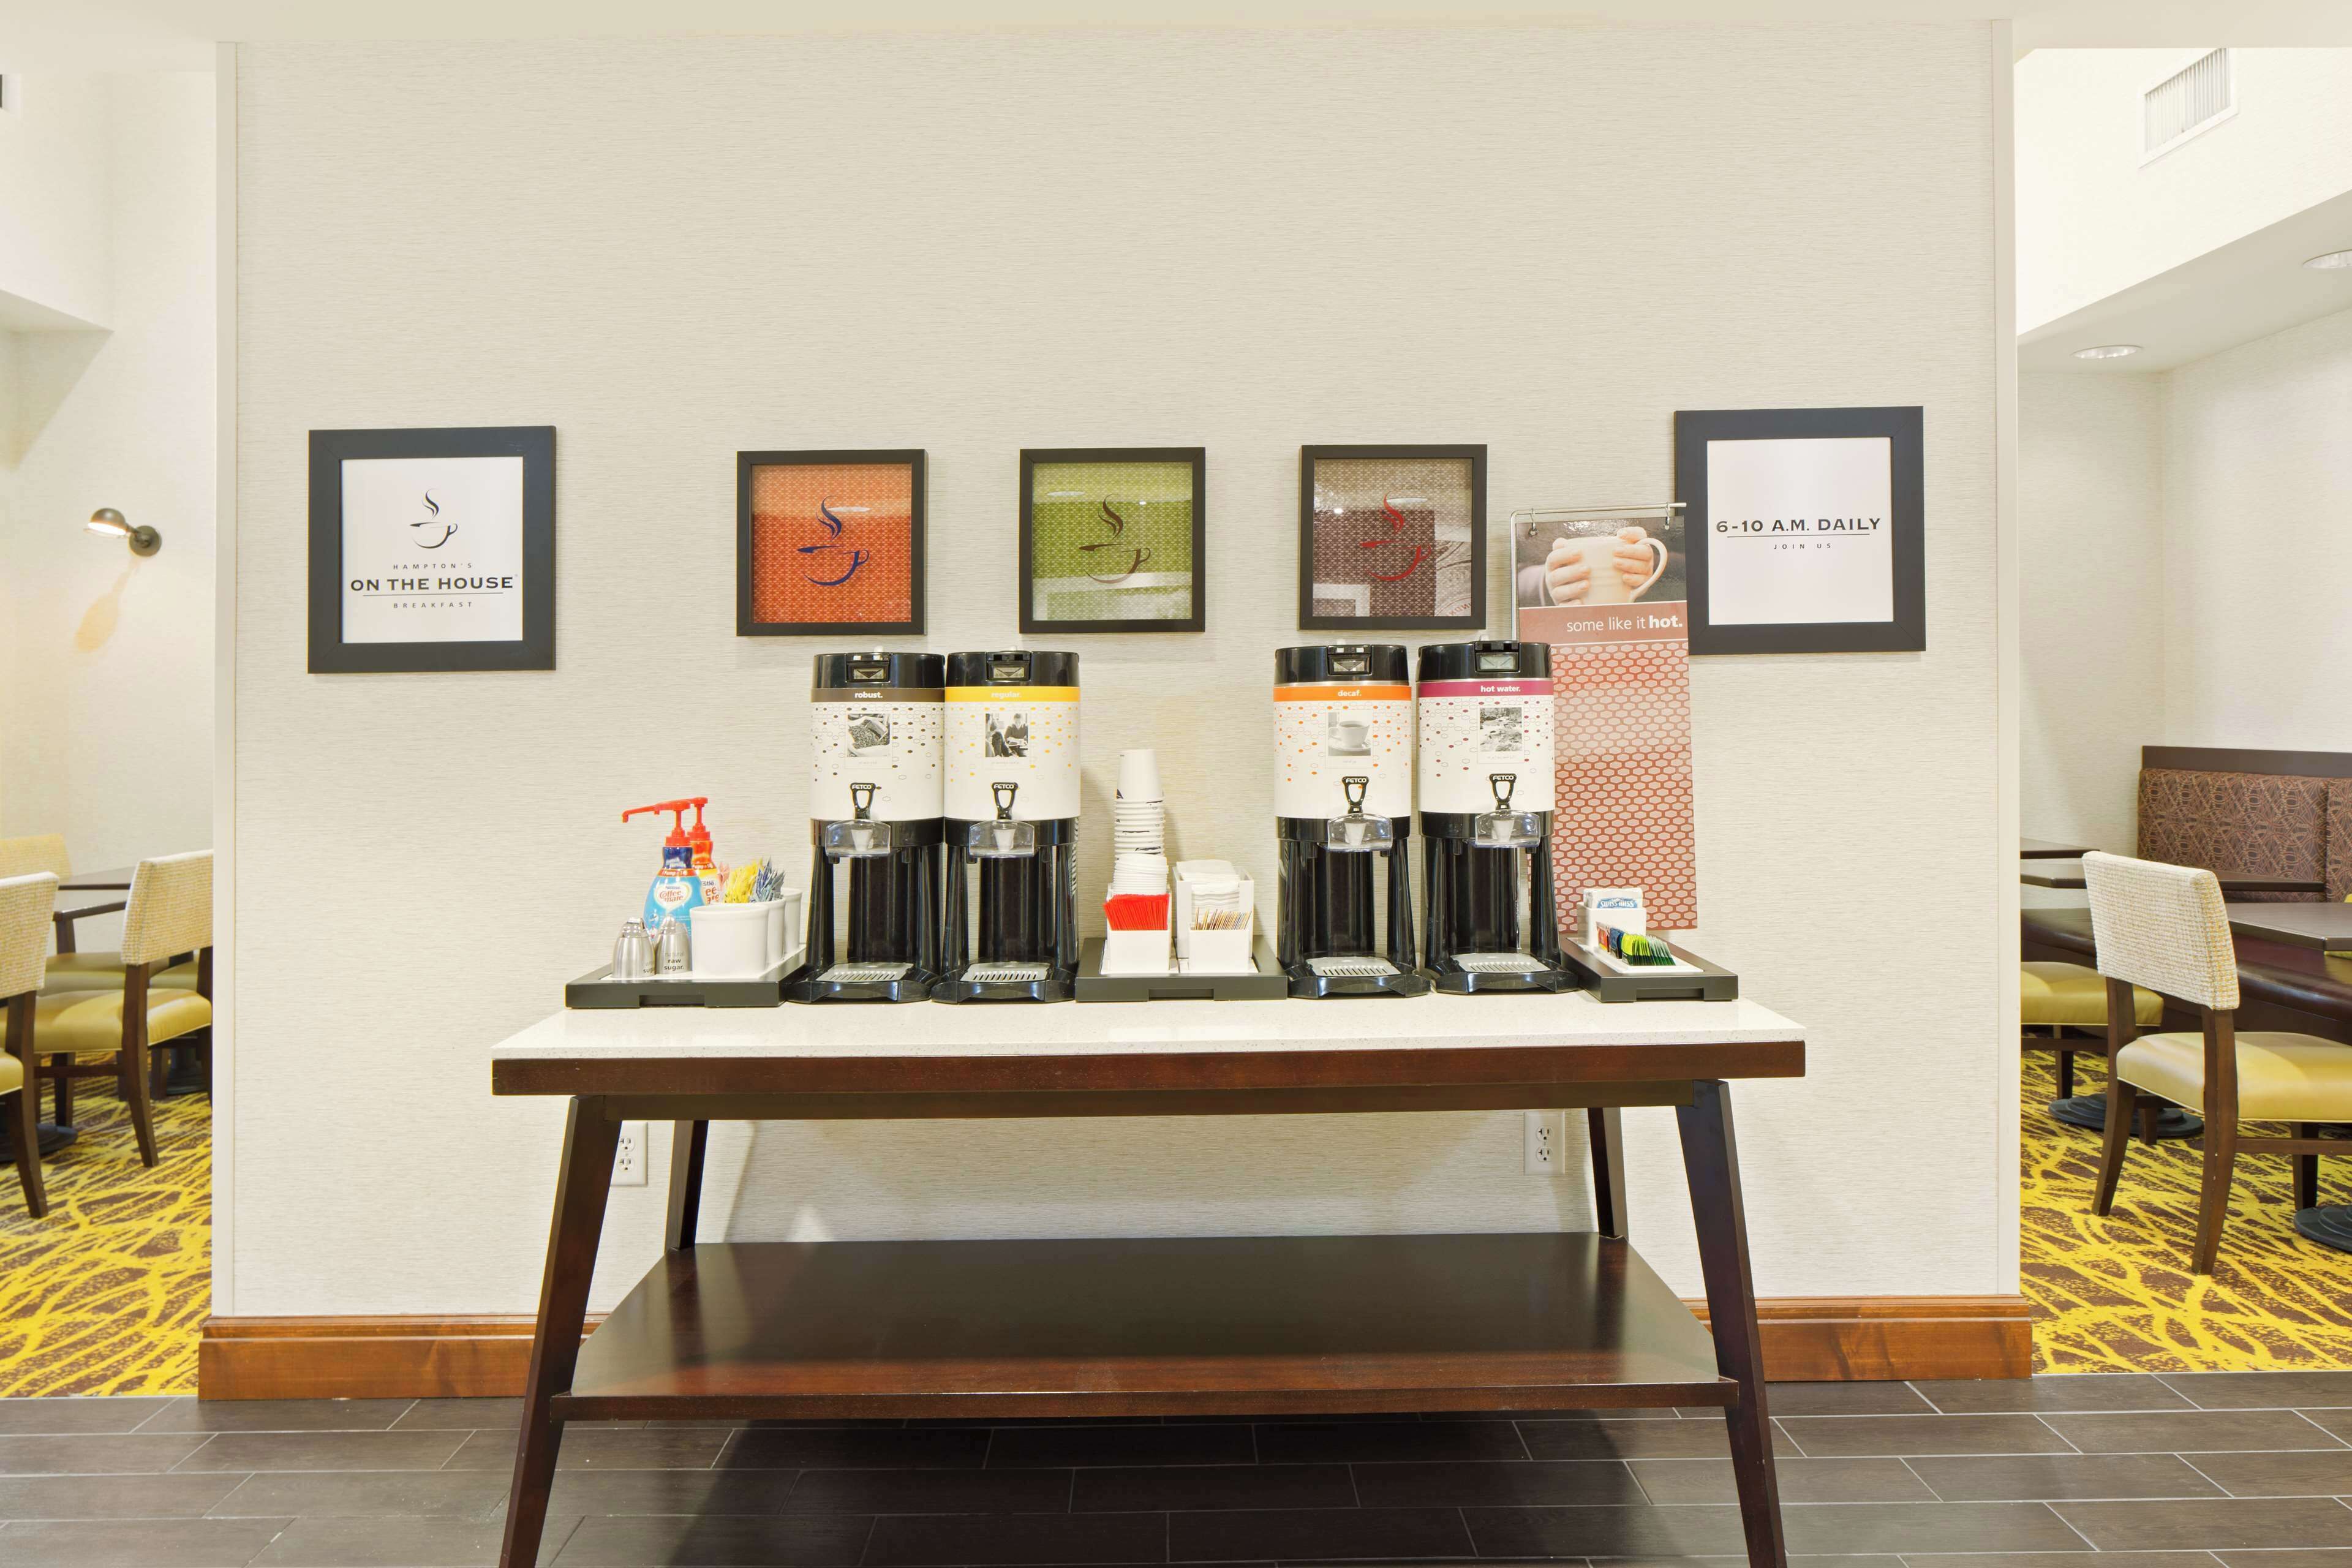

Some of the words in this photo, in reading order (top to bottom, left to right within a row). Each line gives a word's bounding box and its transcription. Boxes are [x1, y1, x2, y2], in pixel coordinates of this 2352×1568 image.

[1716, 520, 1763, 532] 6-10
[1772, 519, 1809, 532] A.M.
[1818, 518, 1880, 530] DAILY
[350, 579, 379, 592] ON
[386, 578, 429, 590] THE
[438, 577, 513, 590] HOUSE
[1567, 620, 1604, 632] some
[1608, 616, 1632, 630] like
[1637, 616, 1646, 629] it
[1649, 615, 1683, 628] hot.
